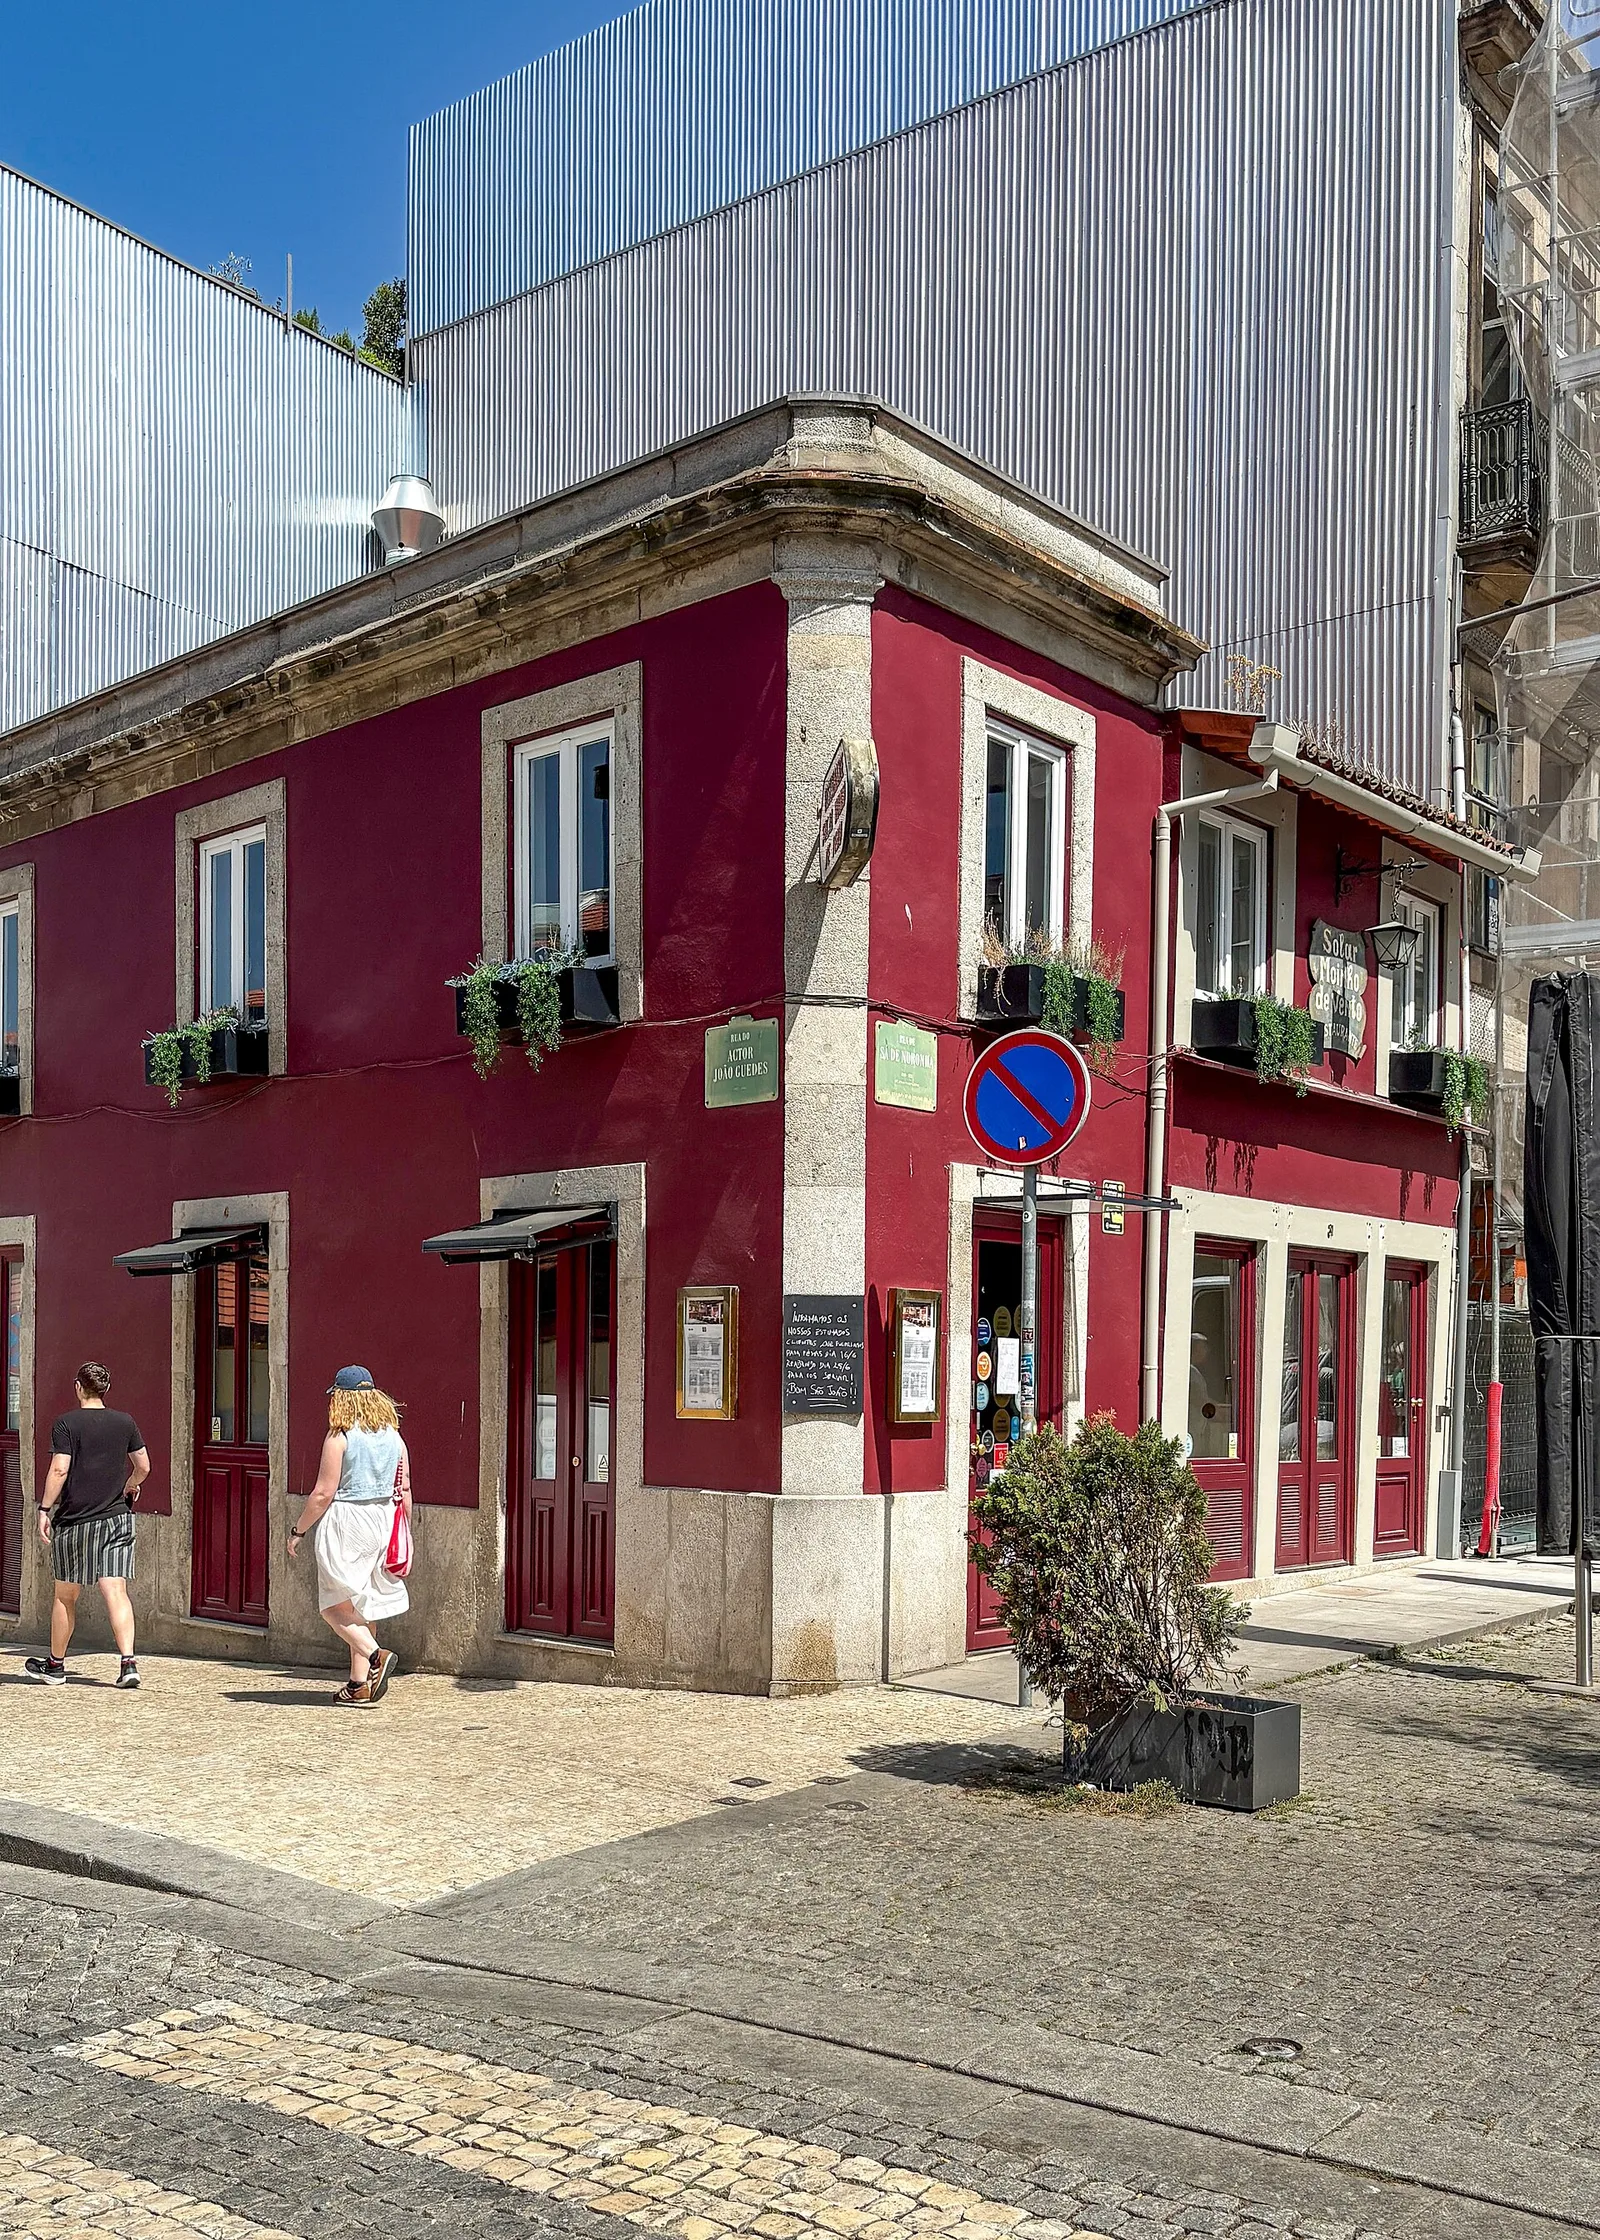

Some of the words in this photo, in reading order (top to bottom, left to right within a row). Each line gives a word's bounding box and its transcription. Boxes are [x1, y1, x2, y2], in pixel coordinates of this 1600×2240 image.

[1322, 928, 1358, 963] Solar
[1315, 981, 1330, 1012] de
[742, 1032, 750, 1041] DO
[727, 1046, 754, 1062] ACTOR
[890, 1047, 900, 1062] DE
[901, 1050, 934, 1069] NORONHA
[713, 1064, 733, 1083] JOÃO
[735, 1061, 768, 1078] GUEDES
[836, 1314, 848, 1324] OS
[787, 1326, 812, 1337] NOSSOS
